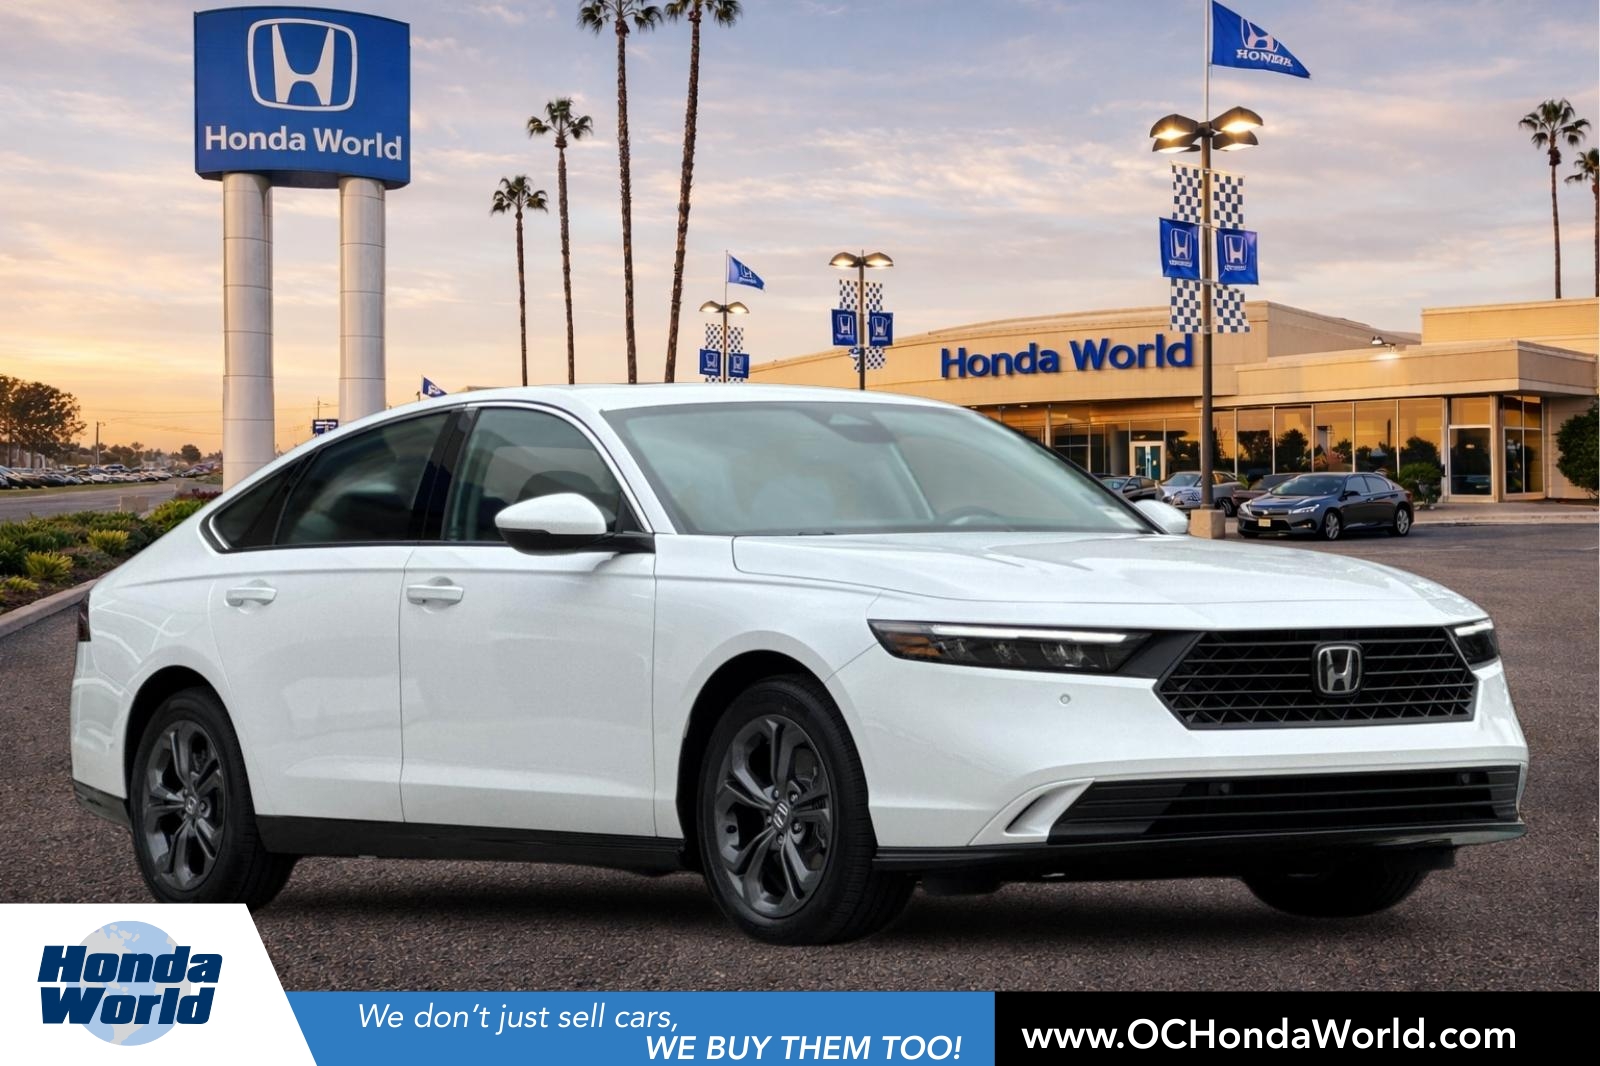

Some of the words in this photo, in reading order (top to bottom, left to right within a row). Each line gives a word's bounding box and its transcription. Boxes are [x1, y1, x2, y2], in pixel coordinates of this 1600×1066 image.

[205, 125, 305, 151] Honda
[313, 127, 402, 161] World
[941, 342, 1060, 379] Honda
[1070, 333, 1194, 371] World
